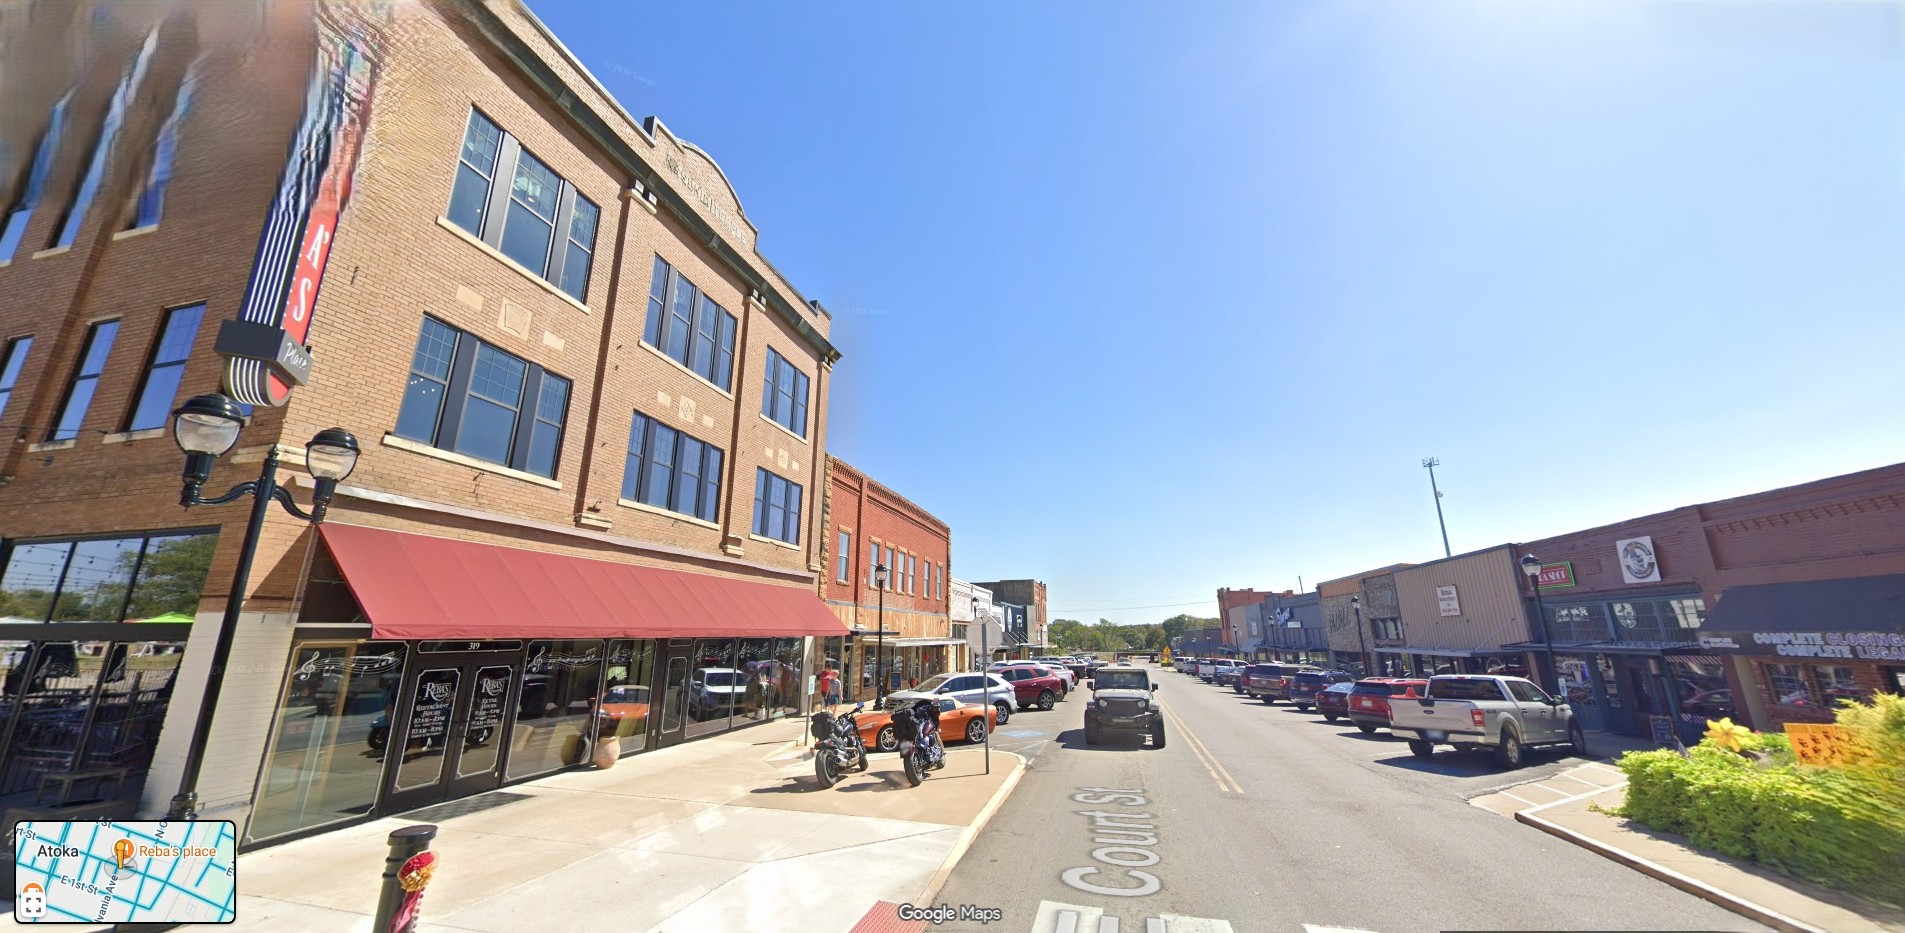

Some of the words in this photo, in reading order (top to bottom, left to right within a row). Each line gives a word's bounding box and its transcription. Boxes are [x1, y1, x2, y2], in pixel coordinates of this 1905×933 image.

[468, 642, 480, 650] 319
[1753, 632, 1824, 644] COMPLETE
[1826, 632, 1905, 646] CLOSING
[1776, 644, 1853, 658] COMPLETE
